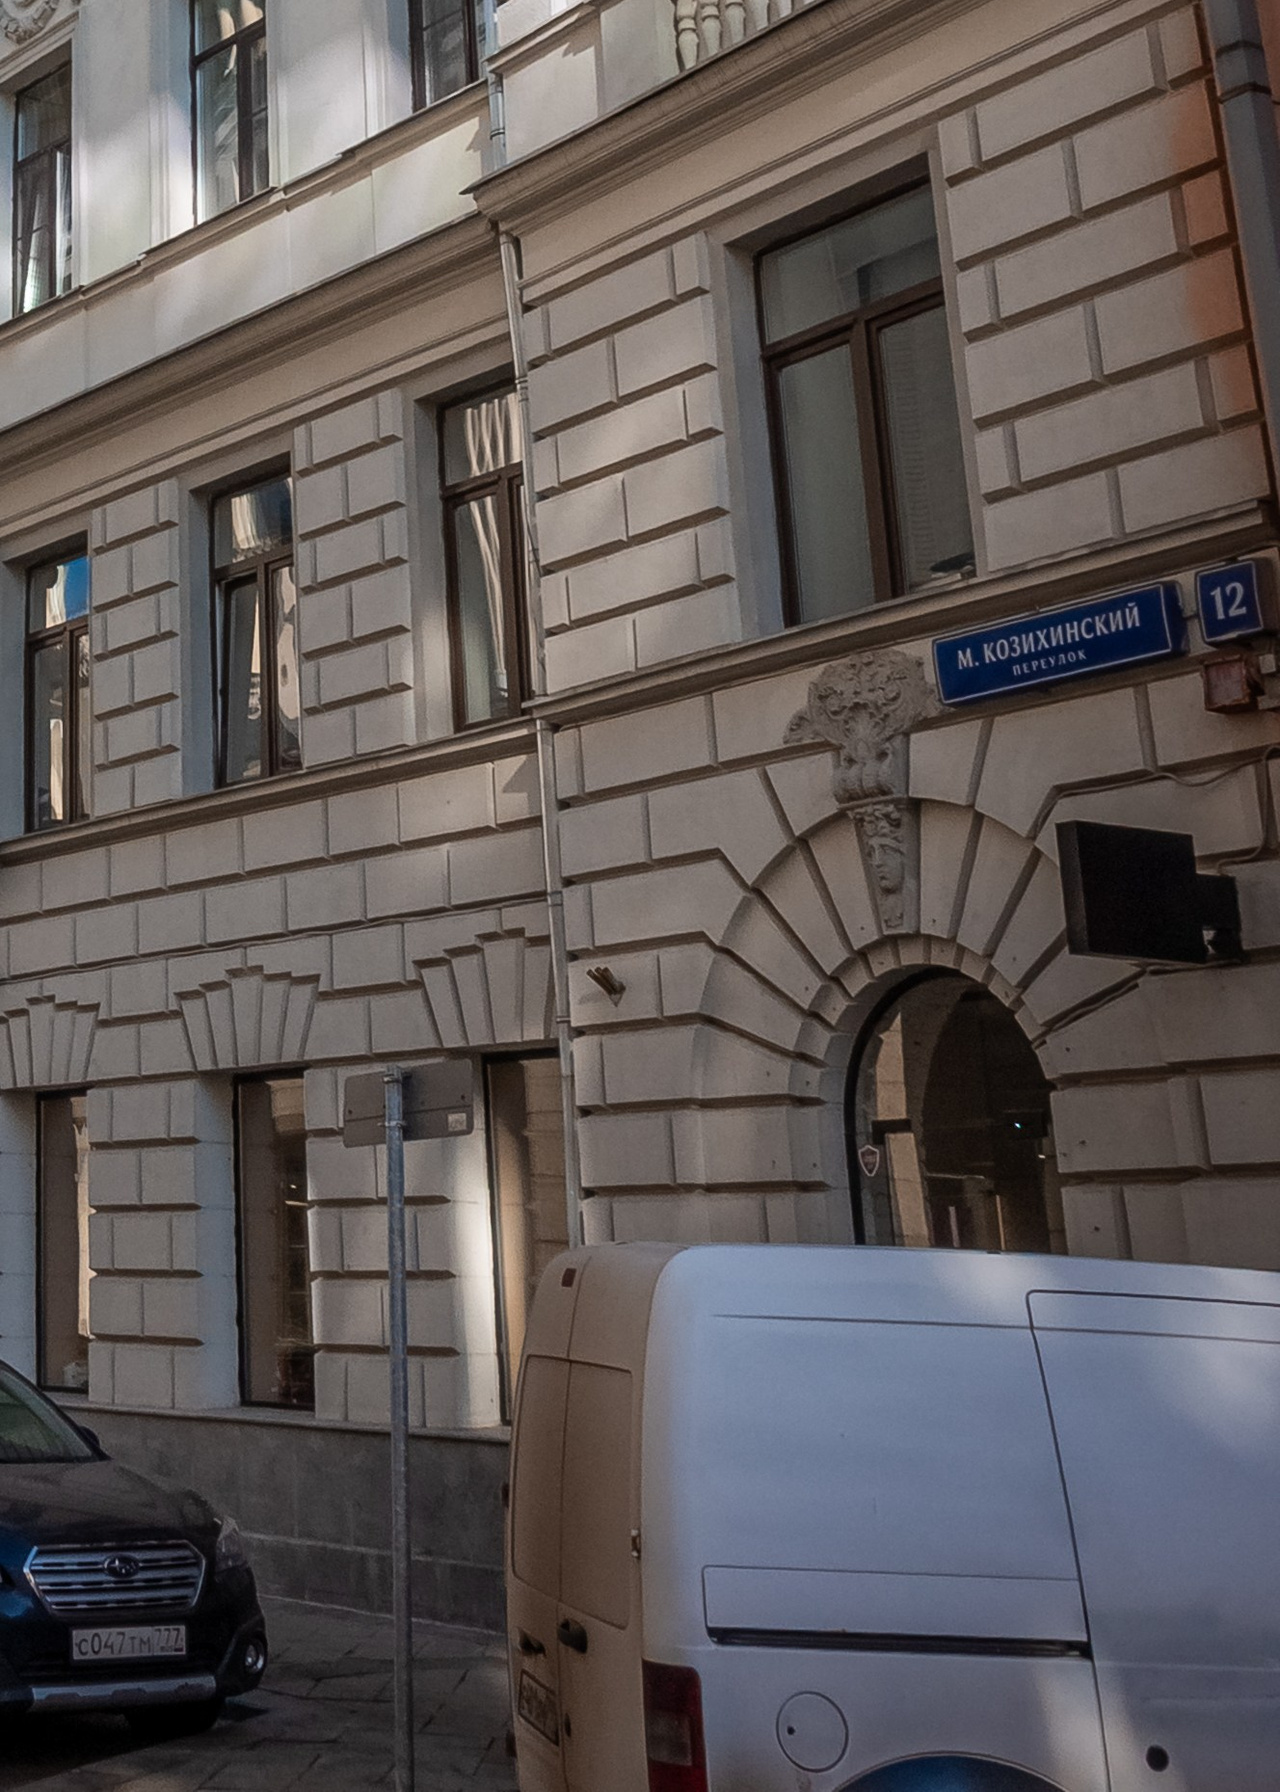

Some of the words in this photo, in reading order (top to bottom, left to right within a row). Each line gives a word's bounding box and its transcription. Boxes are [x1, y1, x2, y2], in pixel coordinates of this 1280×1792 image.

[1209, 581, 1248, 620] 12
[957, 649, 980, 670] М.
[983, 602, 1141, 663] КОЗИХИНСКИЙ
[1013, 649, 1088, 676] ПЕРЕУЛОК
